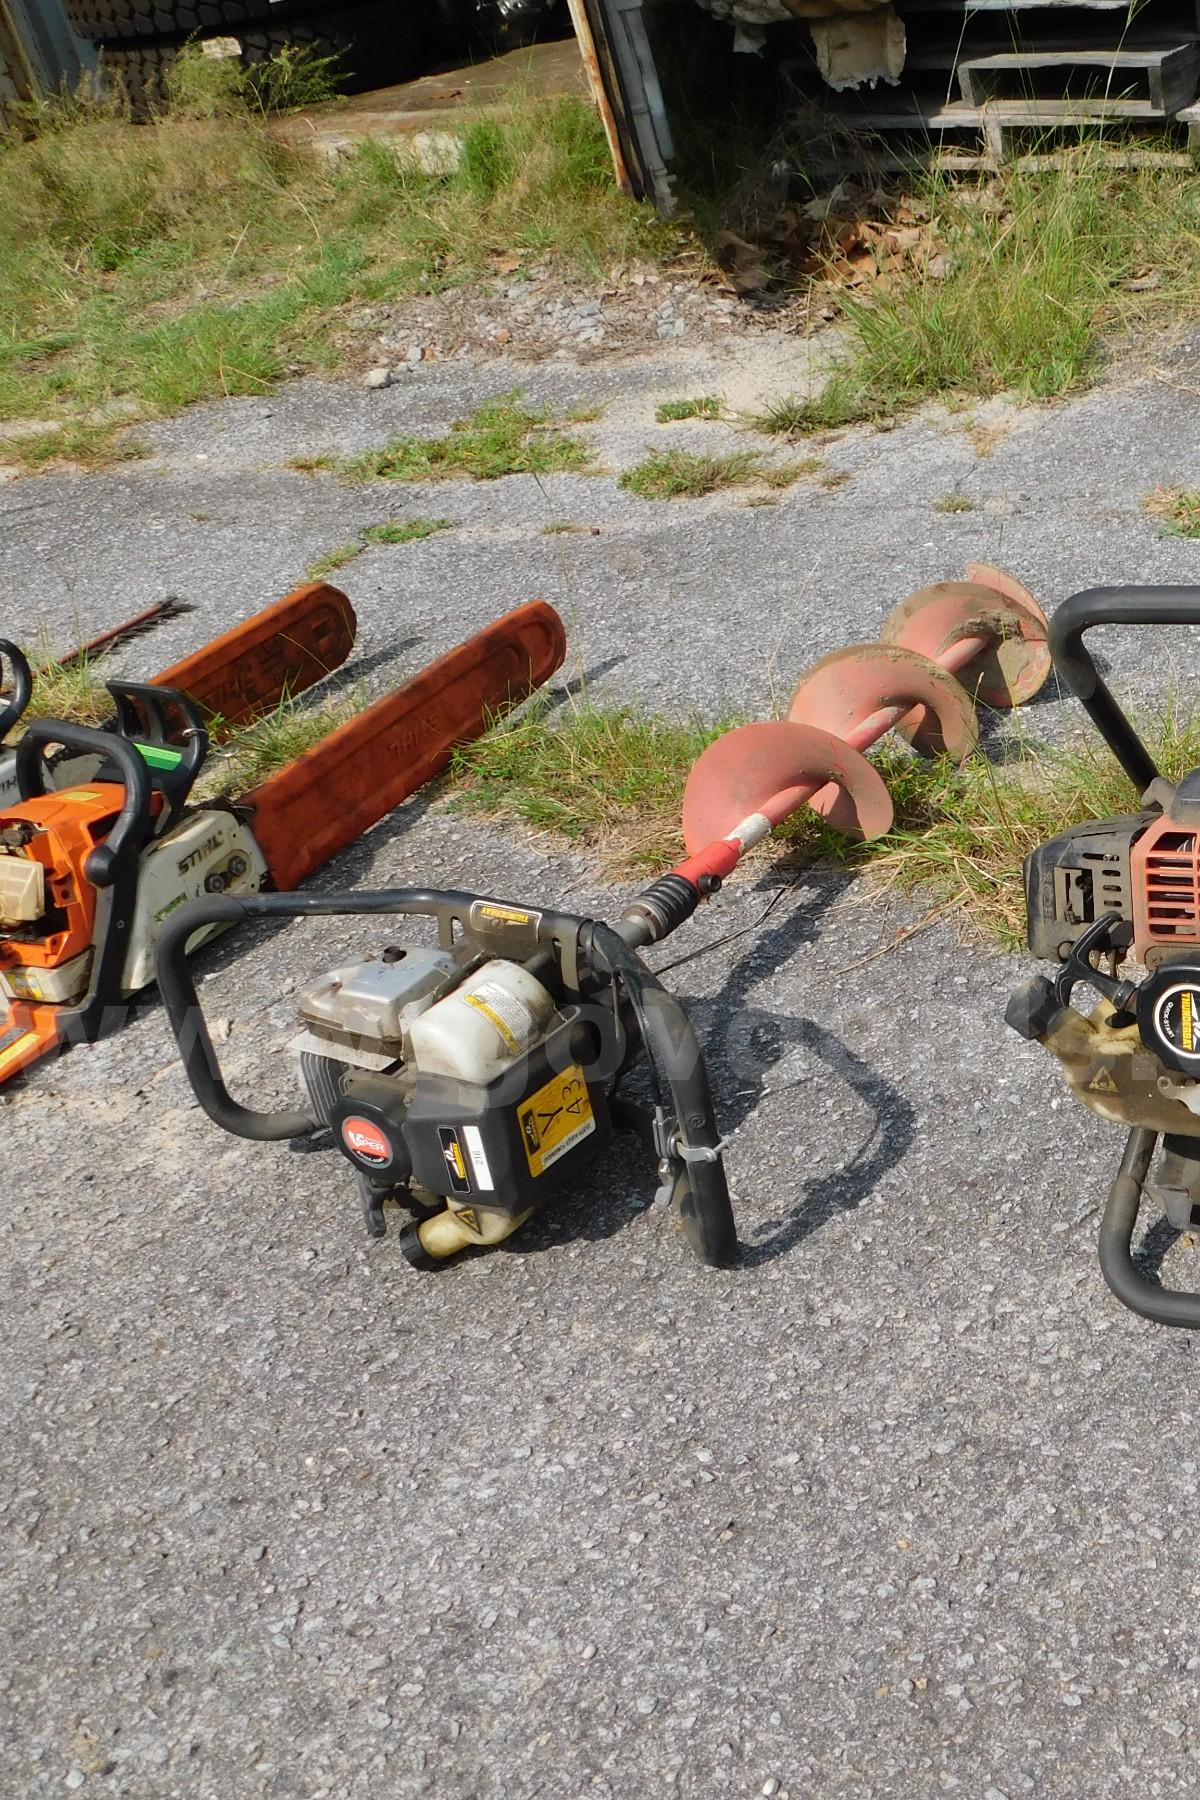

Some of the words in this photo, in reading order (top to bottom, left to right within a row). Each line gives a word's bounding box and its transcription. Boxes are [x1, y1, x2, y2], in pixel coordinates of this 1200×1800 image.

[177, 834, 223, 877] STIHL
[1163, 1001, 1176, 1039] QUICK-START
[1181, 992, 1193, 1051] THUNDERBAY
[347, 1130, 385, 1153] VIPER
